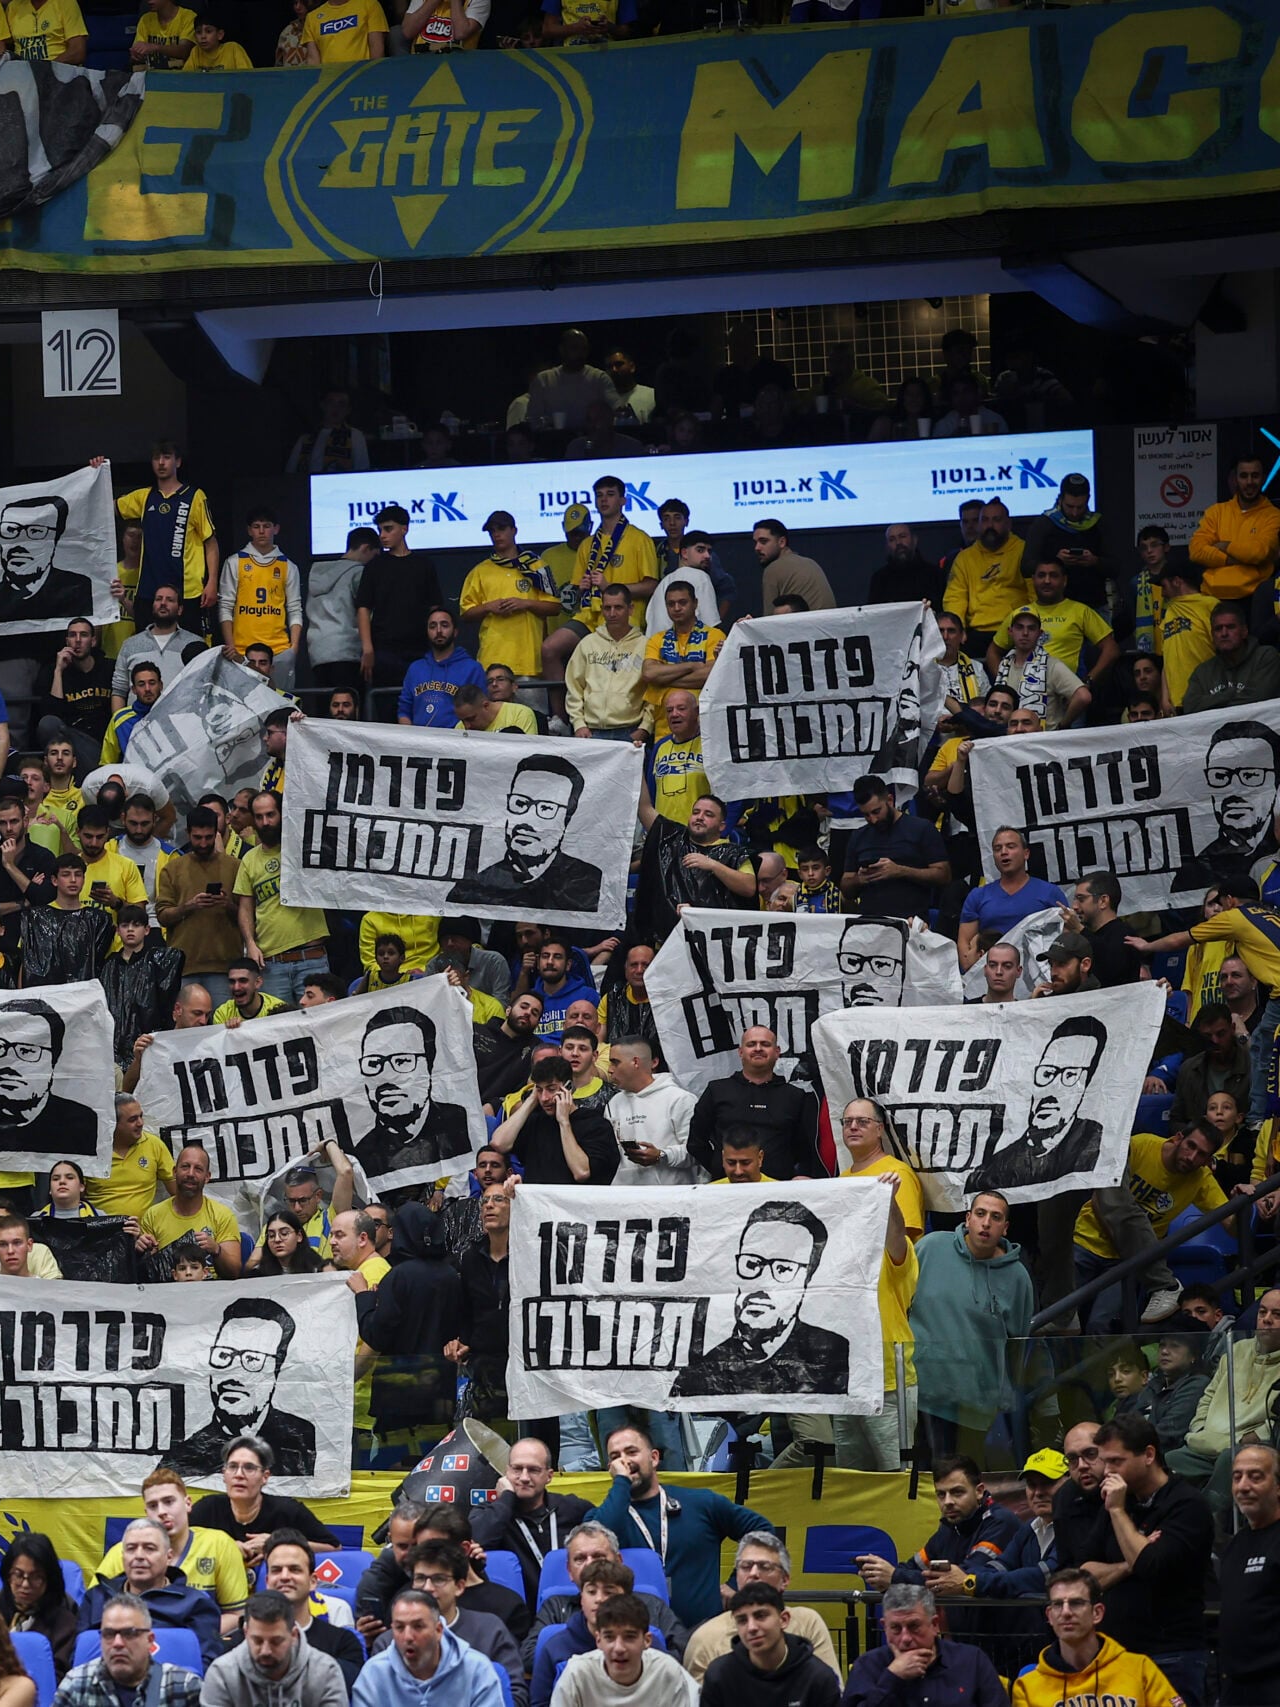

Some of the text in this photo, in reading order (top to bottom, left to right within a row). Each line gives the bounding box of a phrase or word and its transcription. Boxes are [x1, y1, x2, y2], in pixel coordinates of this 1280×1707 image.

[321, 15, 357, 34] FOX
[350, 95, 388, 111] THE
[676, 6, 1280, 209] MAC
[319, 108, 542, 189] GATE
[46, 328, 117, 391] 12
[1138, 429, 1212, 448] אסור לעשן
[539, 491, 593, 511] בוטון
[733, 477, 813, 501] א.בוטון
[931, 465, 1013, 489] א.בוטון
[238, 604, 281, 617] Playtika
[255, 587, 267, 604] 9
[66, 688, 111, 702] MACCABI
[414, 682, 458, 697] MACCABI
[740, 636, 874, 704] פדרמן
[660, 751, 704, 764] ACCAB
[736, 702, 884, 759] תמכור!
[327, 751, 467, 812] פדרמן
[1016, 745, 1161, 826] פדרמן
[309, 814, 470, 879] תמכור!
[1029, 814, 1181, 883] תמכור
[174, 1037, 320, 1123] פדרמן
[847, 1039, 1001, 1099] פדרמן
[538, 1217, 690, 1296] פדרמן
[528, 1301, 696, 1367] תמכור!
